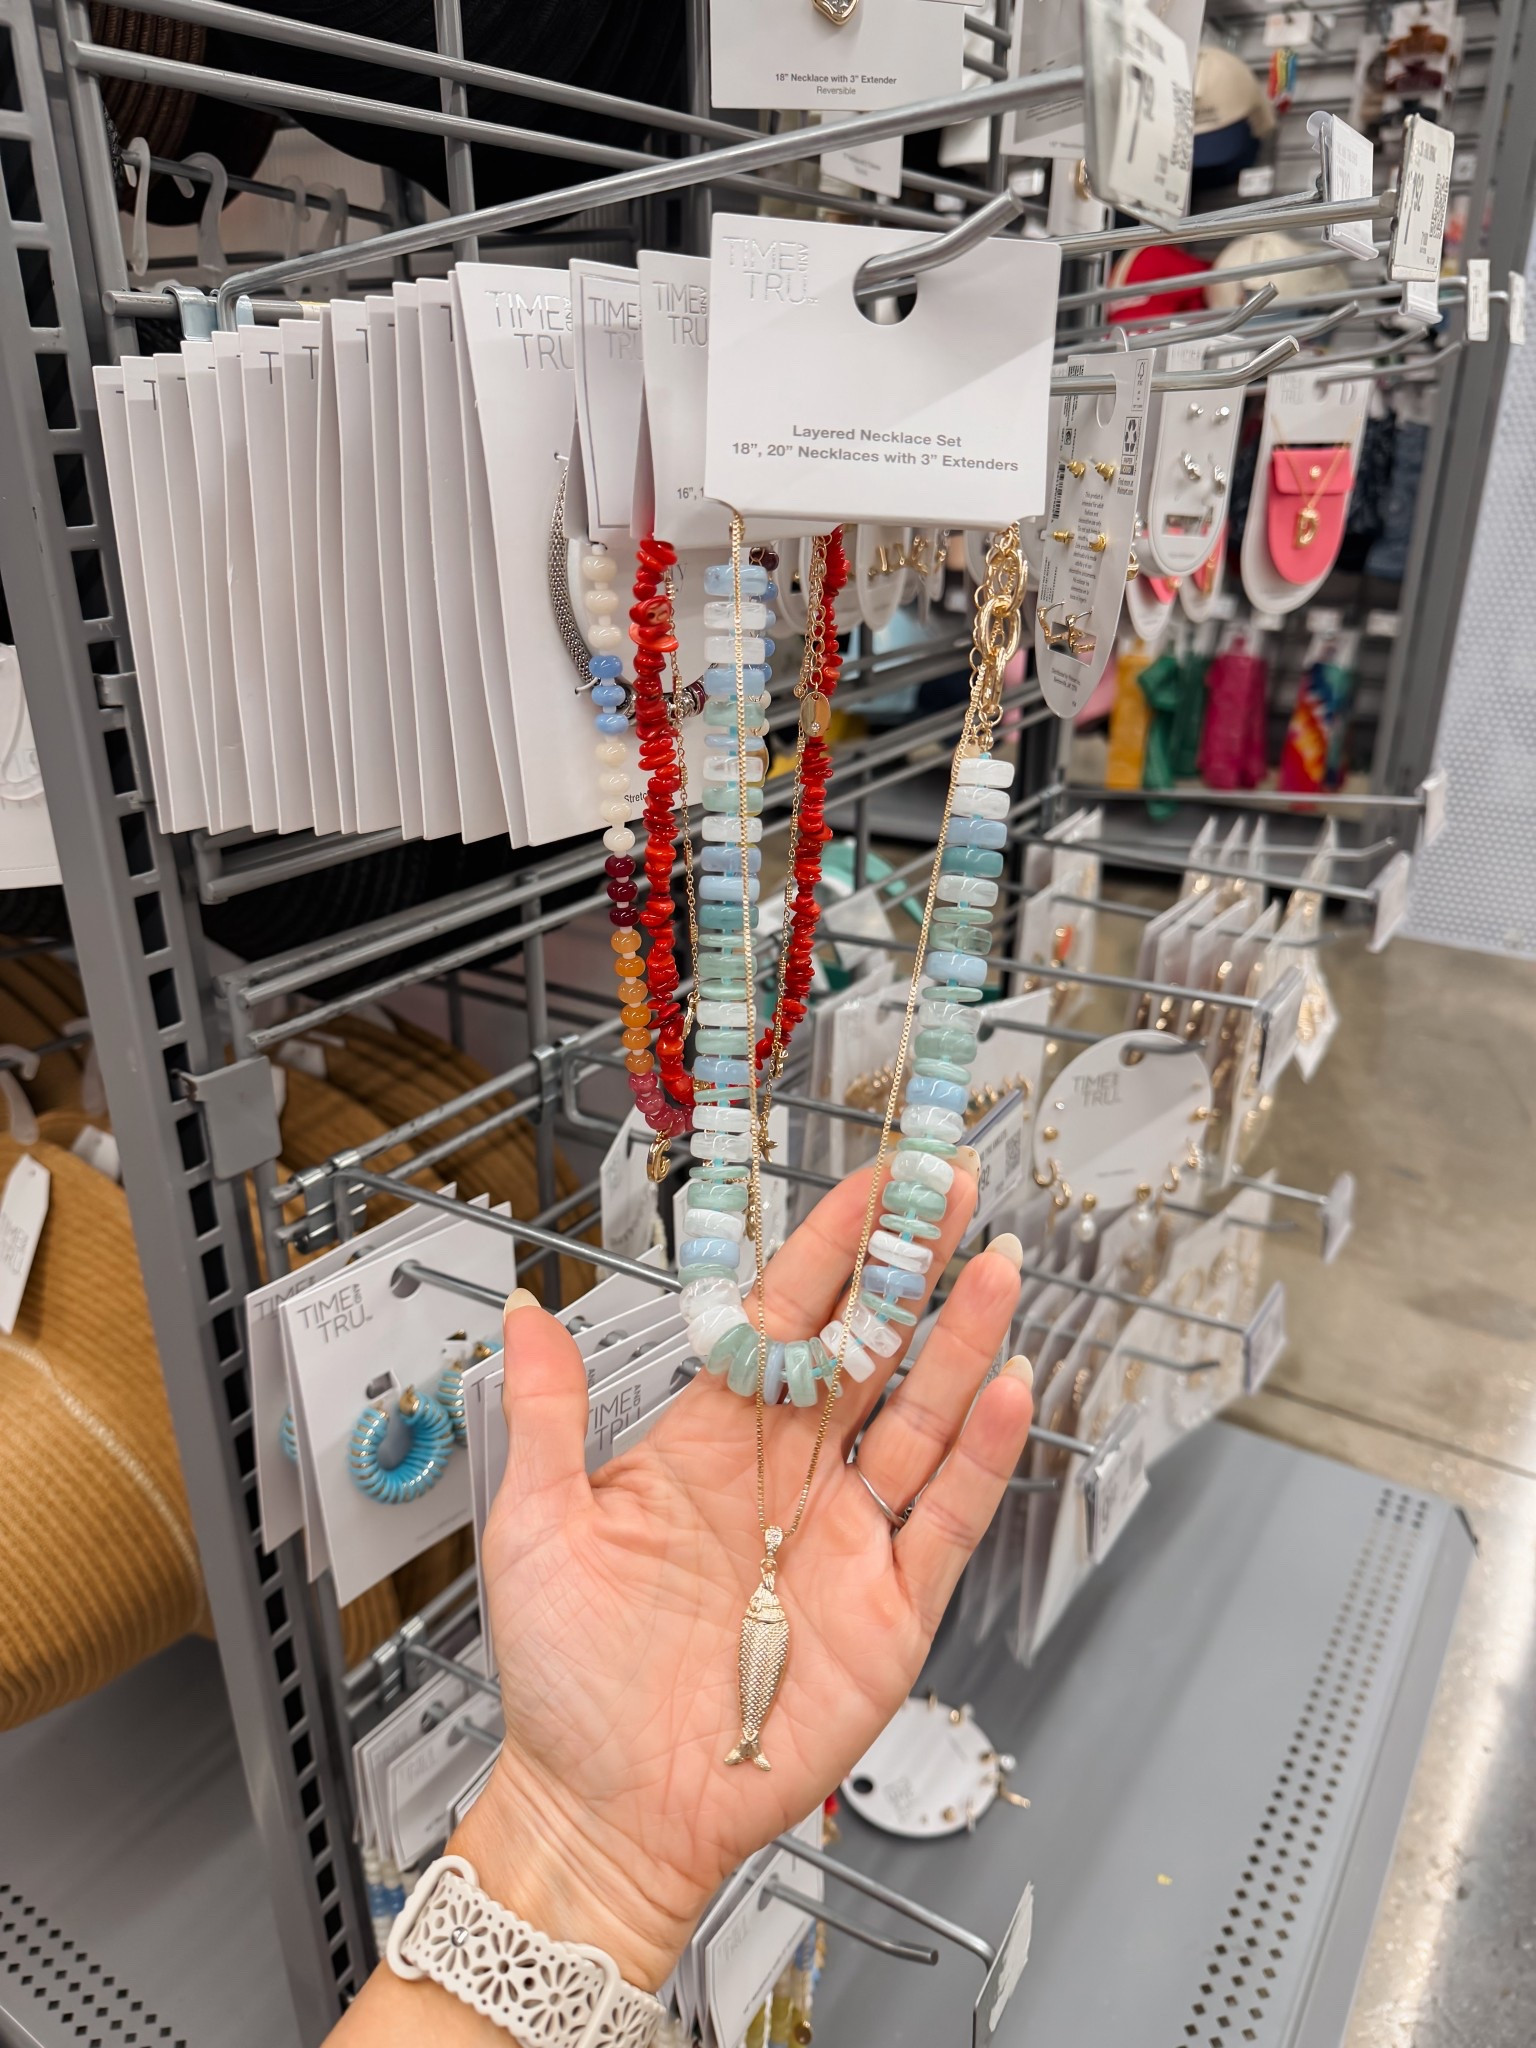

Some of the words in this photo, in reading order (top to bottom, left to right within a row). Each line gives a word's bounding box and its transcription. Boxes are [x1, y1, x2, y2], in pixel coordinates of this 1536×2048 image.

[791, 73, 829, 83] Necklace
[830, 74, 849, 83] with
[861, 75, 897, 84] Extender
[816, 86, 856, 94] Reversible
[722, 236, 796, 271] TIME
[797, 243, 809, 272] AND
[652, 280, 699, 314] TIME
[743, 270, 808, 305] TRU
[484, 290, 564, 331] TIME
[588, 296, 639, 331] TIME
[668, 315, 709, 347] TRU
[792, 424, 856, 441] Layered
[860, 429, 932, 445] Necklace
[936, 434, 962, 448] Set
[798, 446, 879, 463] Necklaces
[884, 451, 916, 465] with
[942, 455, 1019, 472] Extenders
[624, 792, 647, 804] Stretc
[297, 1285, 353, 1329] TIME
[317, 1304, 366, 1343] TRU
[633, 1384, 641, 1407] AND
